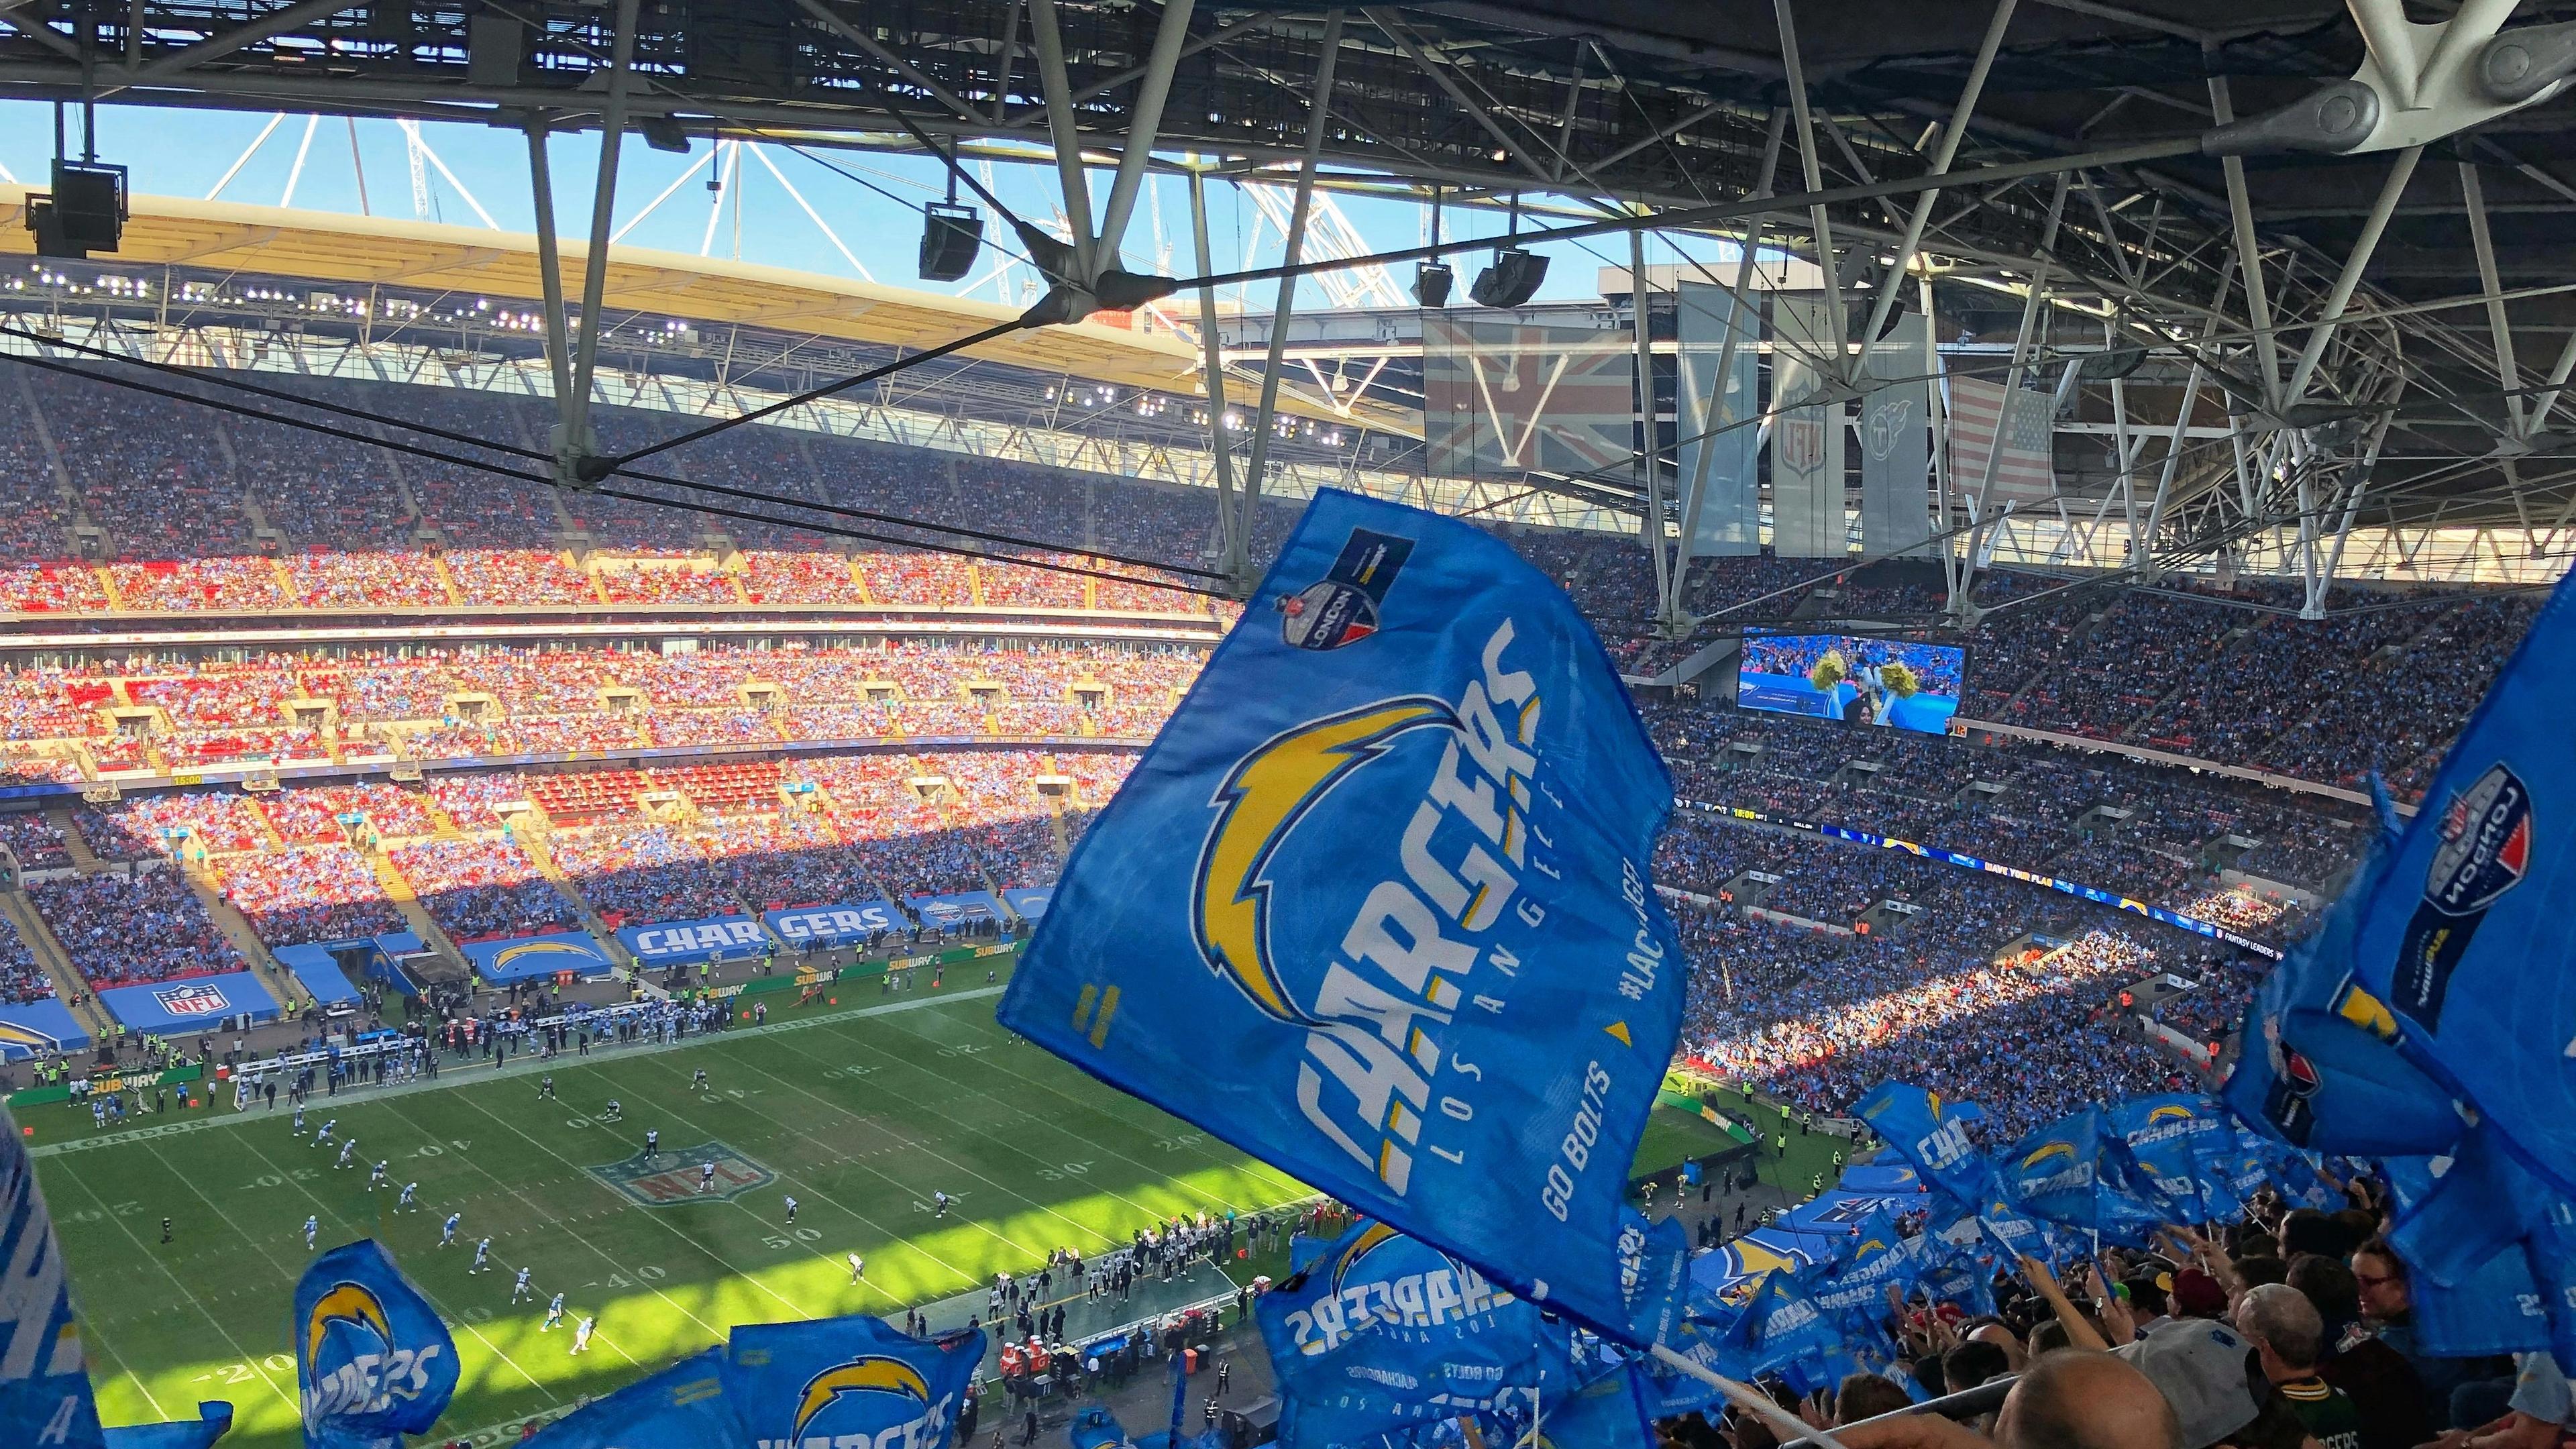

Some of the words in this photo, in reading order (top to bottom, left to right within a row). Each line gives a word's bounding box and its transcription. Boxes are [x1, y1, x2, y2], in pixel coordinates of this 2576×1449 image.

[1309, 590, 1352, 648] LONDON
[713, 744, 738, 753] WAVE
[740, 743, 761, 752] YOUR
[173, 775, 201, 786] 15:00
[1733, 807, 1755, 820] 15:00
[1984, 861, 2008, 876] WAVE
[2009, 867, 2030, 881] YOUR
[2031, 874, 2053, 888] FLAG
[1296, 616, 1542, 1197] CHARGERS
[778, 906, 890, 938] GERS
[637, 920, 764, 955] CHAR
[975, 942, 1018, 958] SUBWAY
[2224, 932, 2250, 948] FANTASY
[2250, 941, 2274, 958] LEADERS
[887, 955, 934, 972] SUBWAY
[168, 994, 223, 1014] NFL
[755, 1010, 861, 1034] LONDON
[1430, 1055, 1482, 1167] LOS
[1701, 1105, 1732, 1132] SUBWAY
[58, 1118, 211, 1154] LONDON
[1542, 1163, 1575, 1222] GO
[1560, 1059, 1611, 1173] BOLTS
[761, 1228, 822, 1250] 50
[216, 1353, 297, 1386] 20
